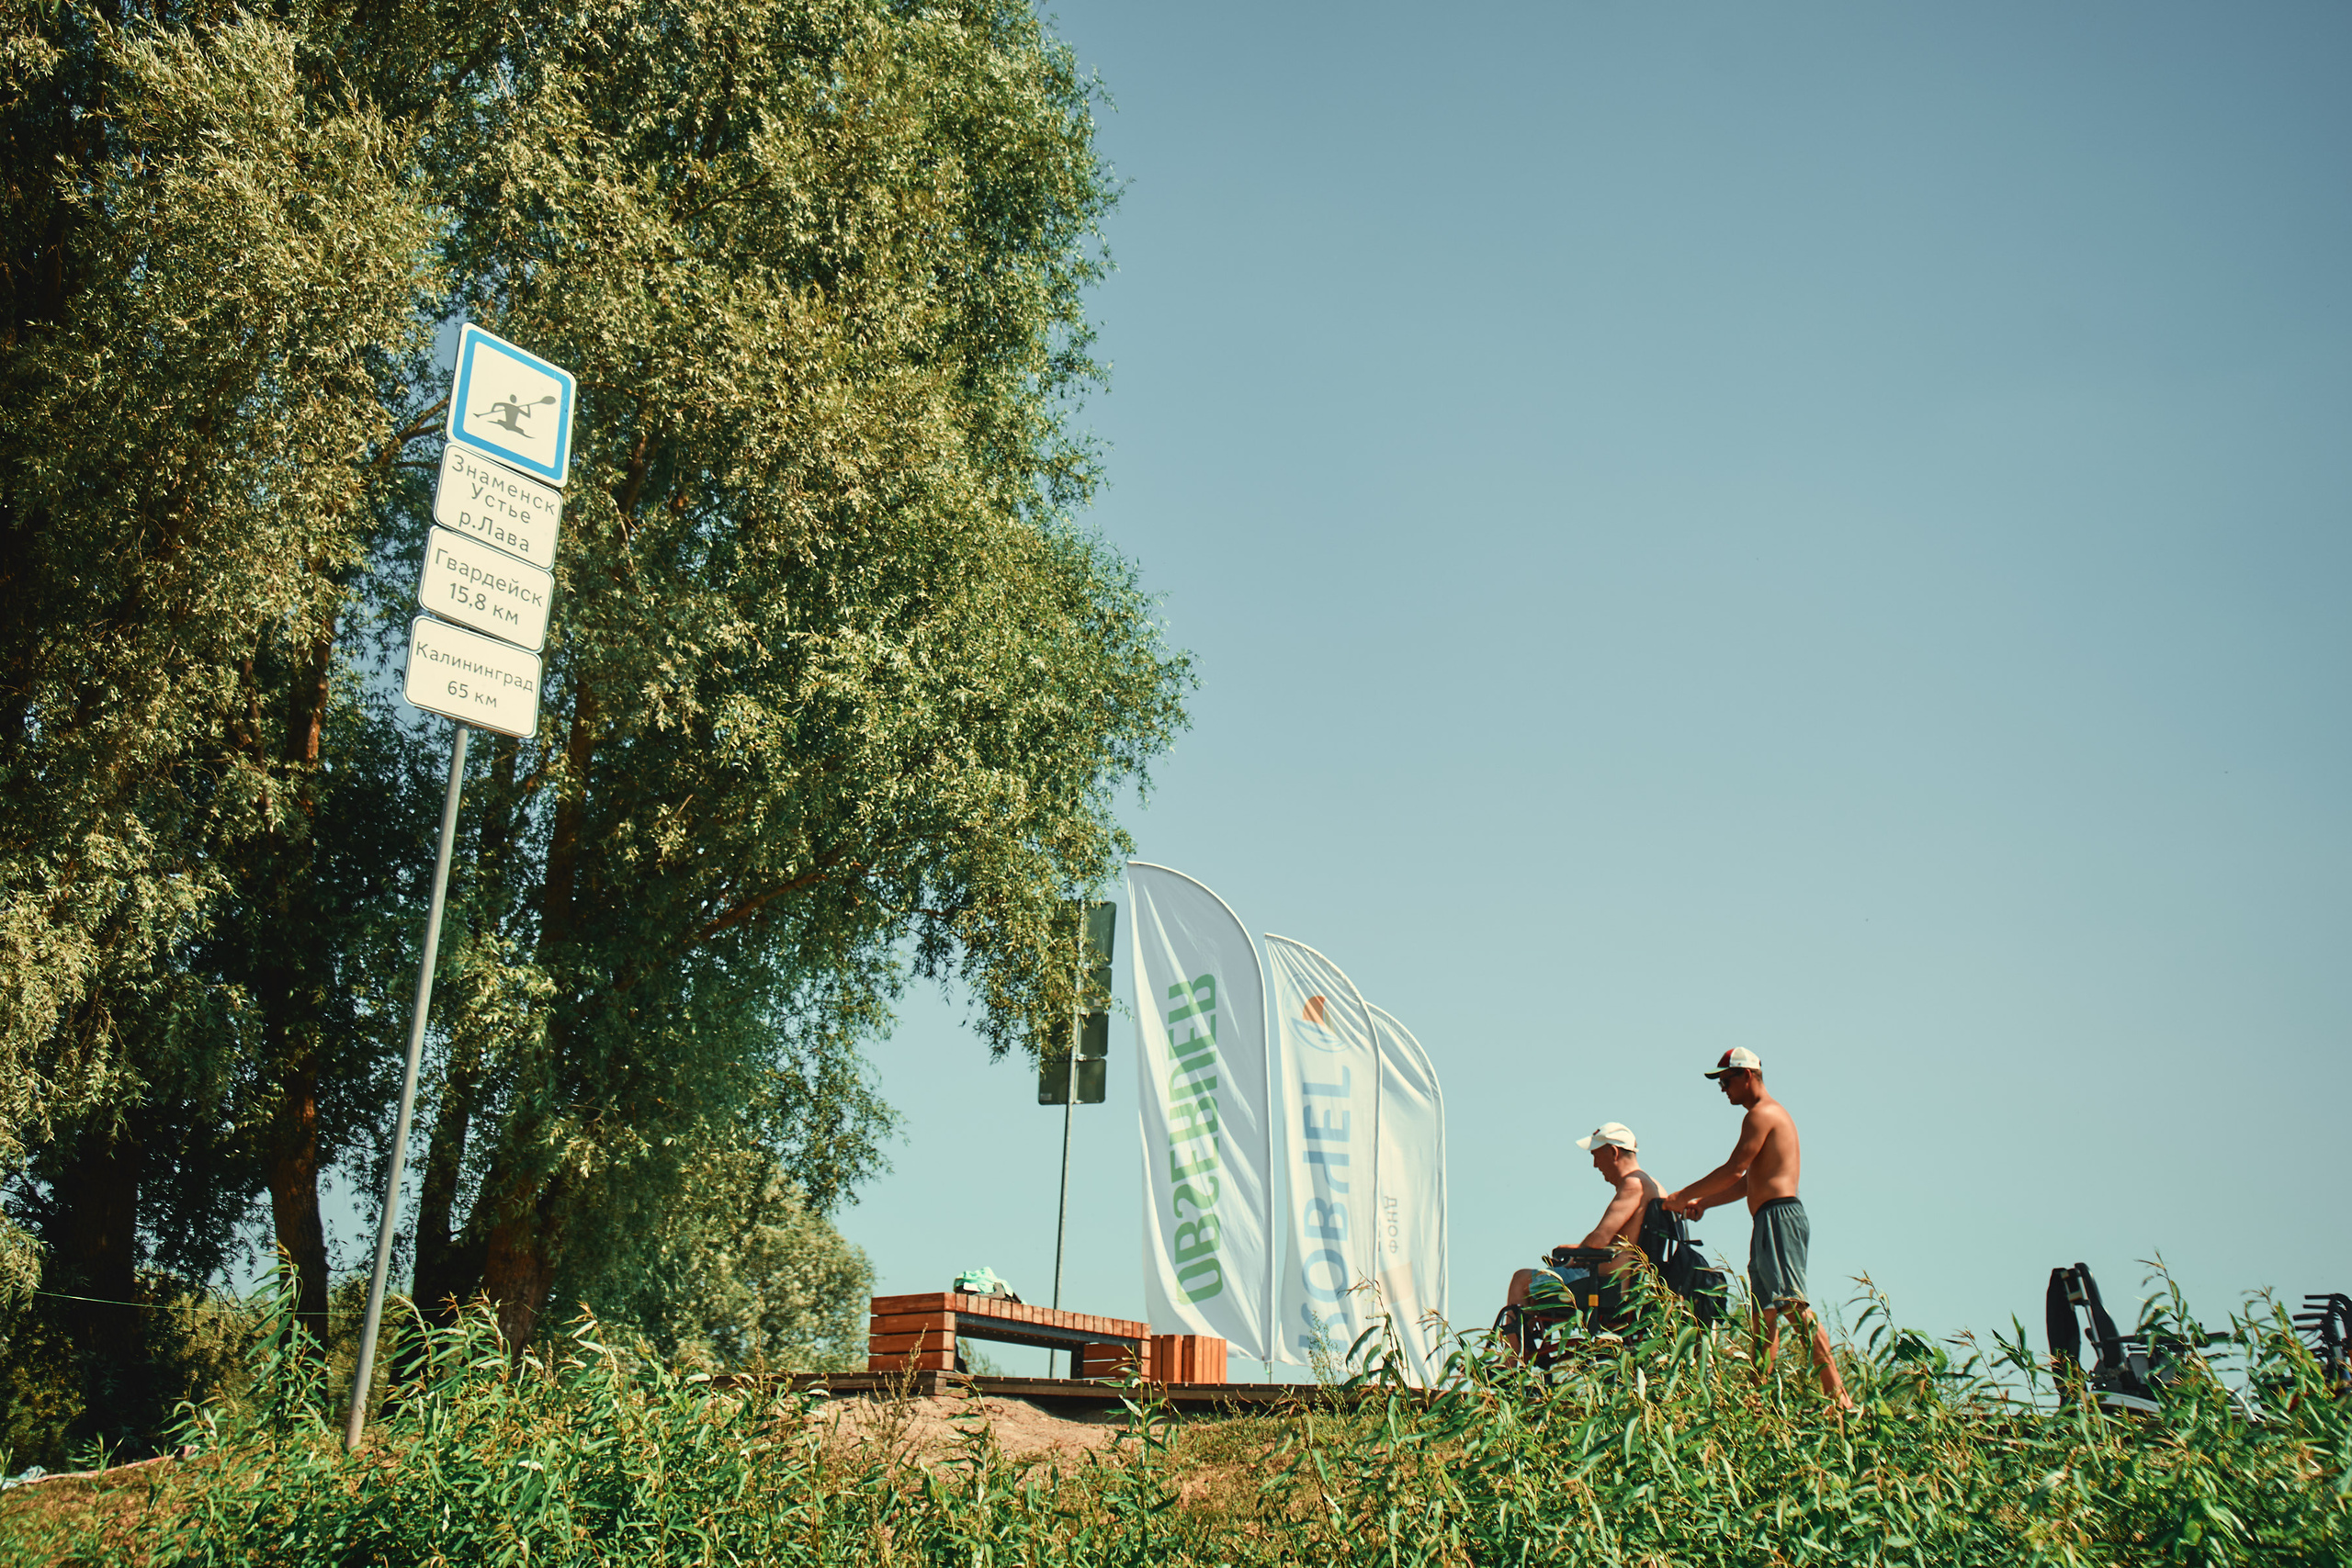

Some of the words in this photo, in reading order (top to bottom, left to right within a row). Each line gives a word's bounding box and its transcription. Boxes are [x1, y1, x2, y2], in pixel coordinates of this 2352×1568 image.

[452, 454, 555, 515] Знаменск
[471, 483, 530, 524] Устье
[458, 511, 529, 552] р.Лава
[435, 548, 542, 607] Гвардейск
[449, 582, 487, 612] 15,8
[492, 605, 519, 626] км
[416, 641, 534, 692] Калининград
[447, 681, 469, 699] 65
[475, 692, 497, 708] км
